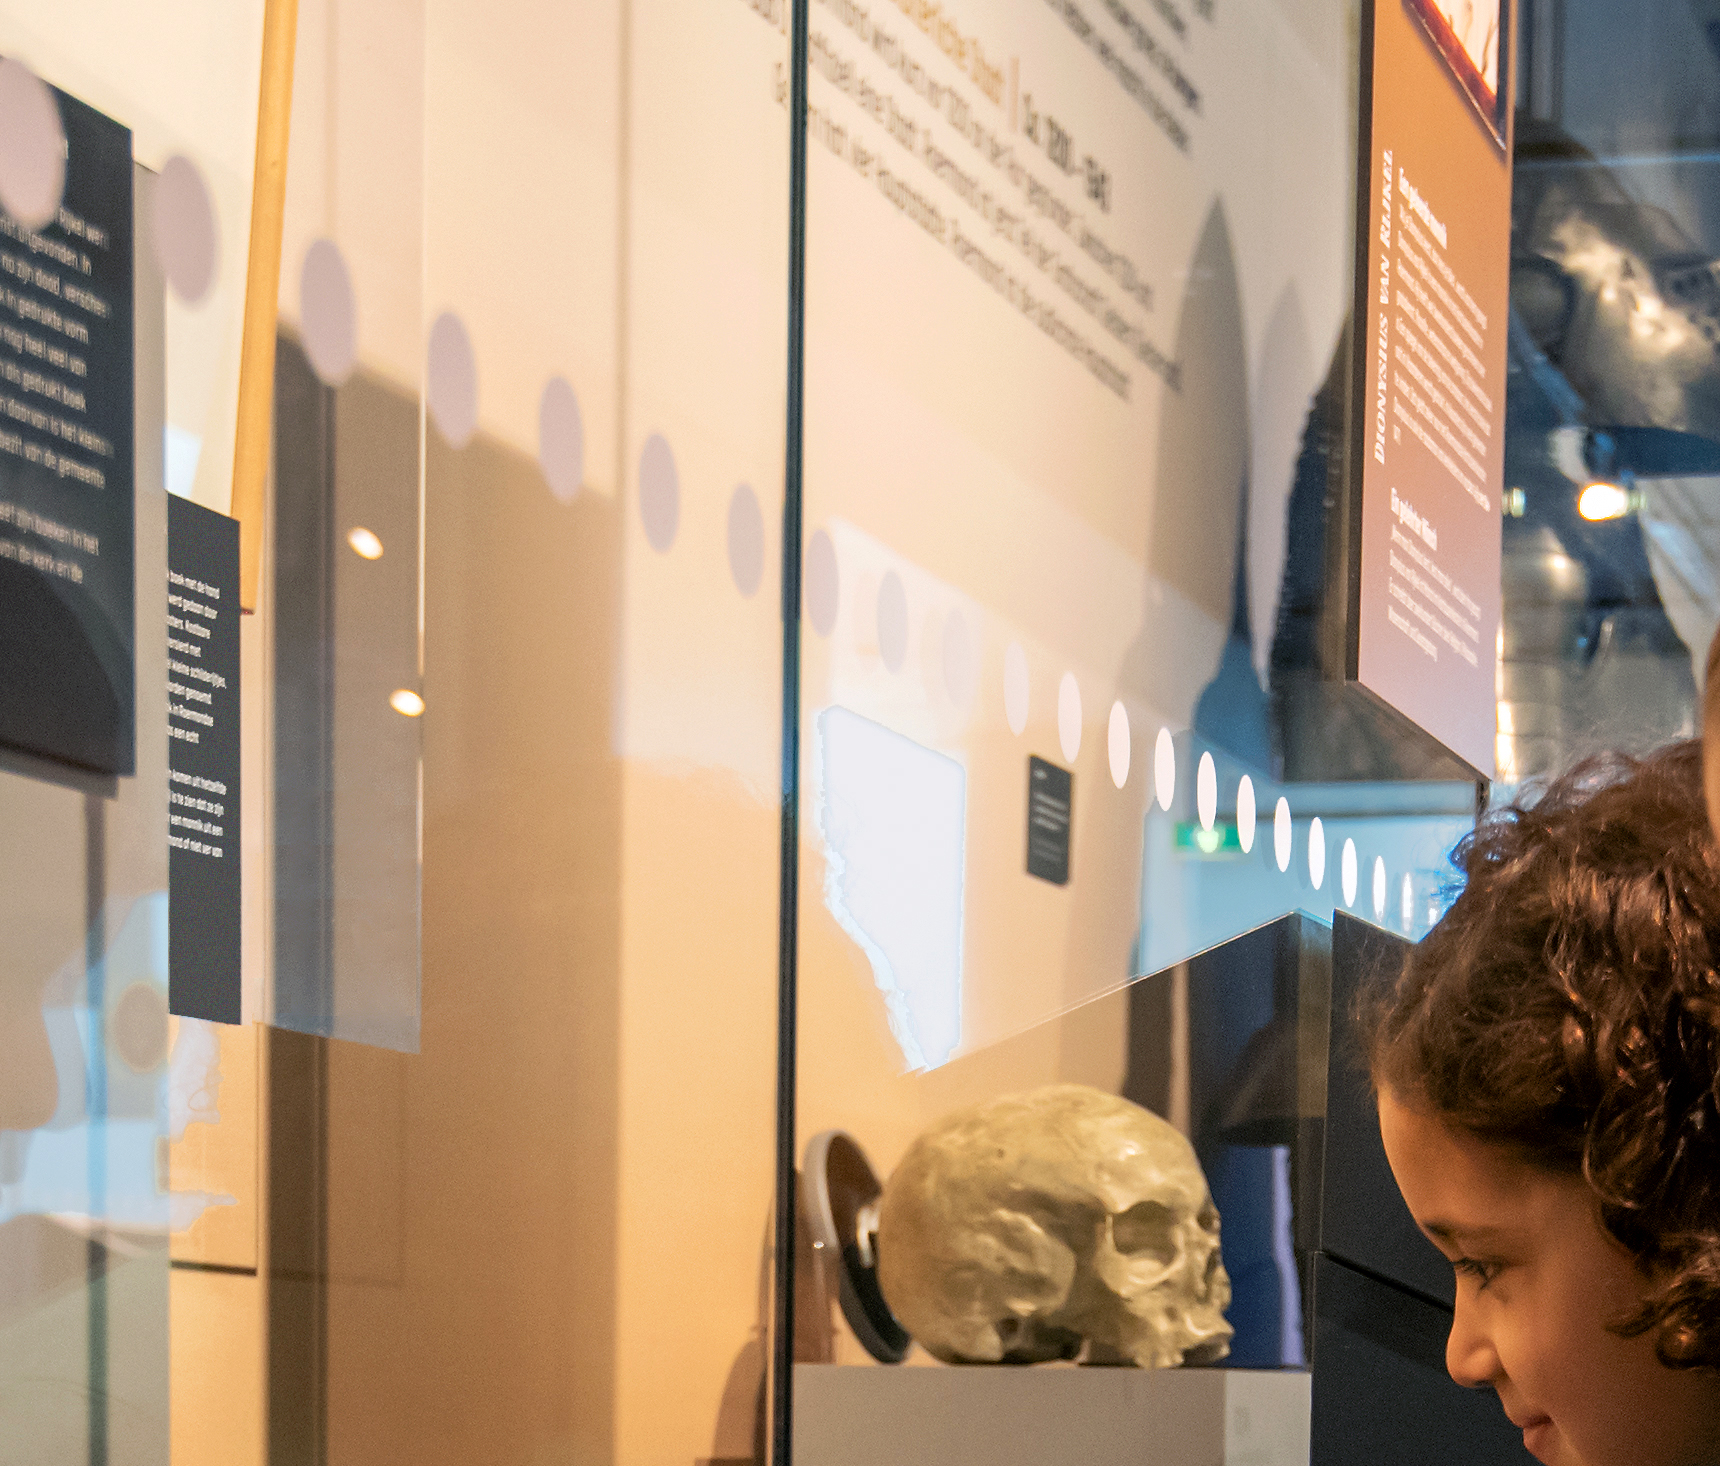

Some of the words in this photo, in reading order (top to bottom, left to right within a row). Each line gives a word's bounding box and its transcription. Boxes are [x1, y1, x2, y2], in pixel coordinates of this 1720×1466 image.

[7, 289, 16, 311] in
[19, 298, 62, 332] gedrukte
[4, 327, 22, 354] nog
[24, 332, 46, 361] heel
[48, 347, 68, 370] veel
[22, 371, 60, 402] gedrukt
[63, 385, 85, 413] boek
[50, 414, 59, 437] is
[61, 419, 76, 444] het
[44, 447, 57, 471] de
[58, 457, 105, 490] gemeente
[19, 544, 31, 567] de
[35, 513, 71, 546] boeken
[73, 528, 81, 550] in
[83, 532, 98, 556] het
